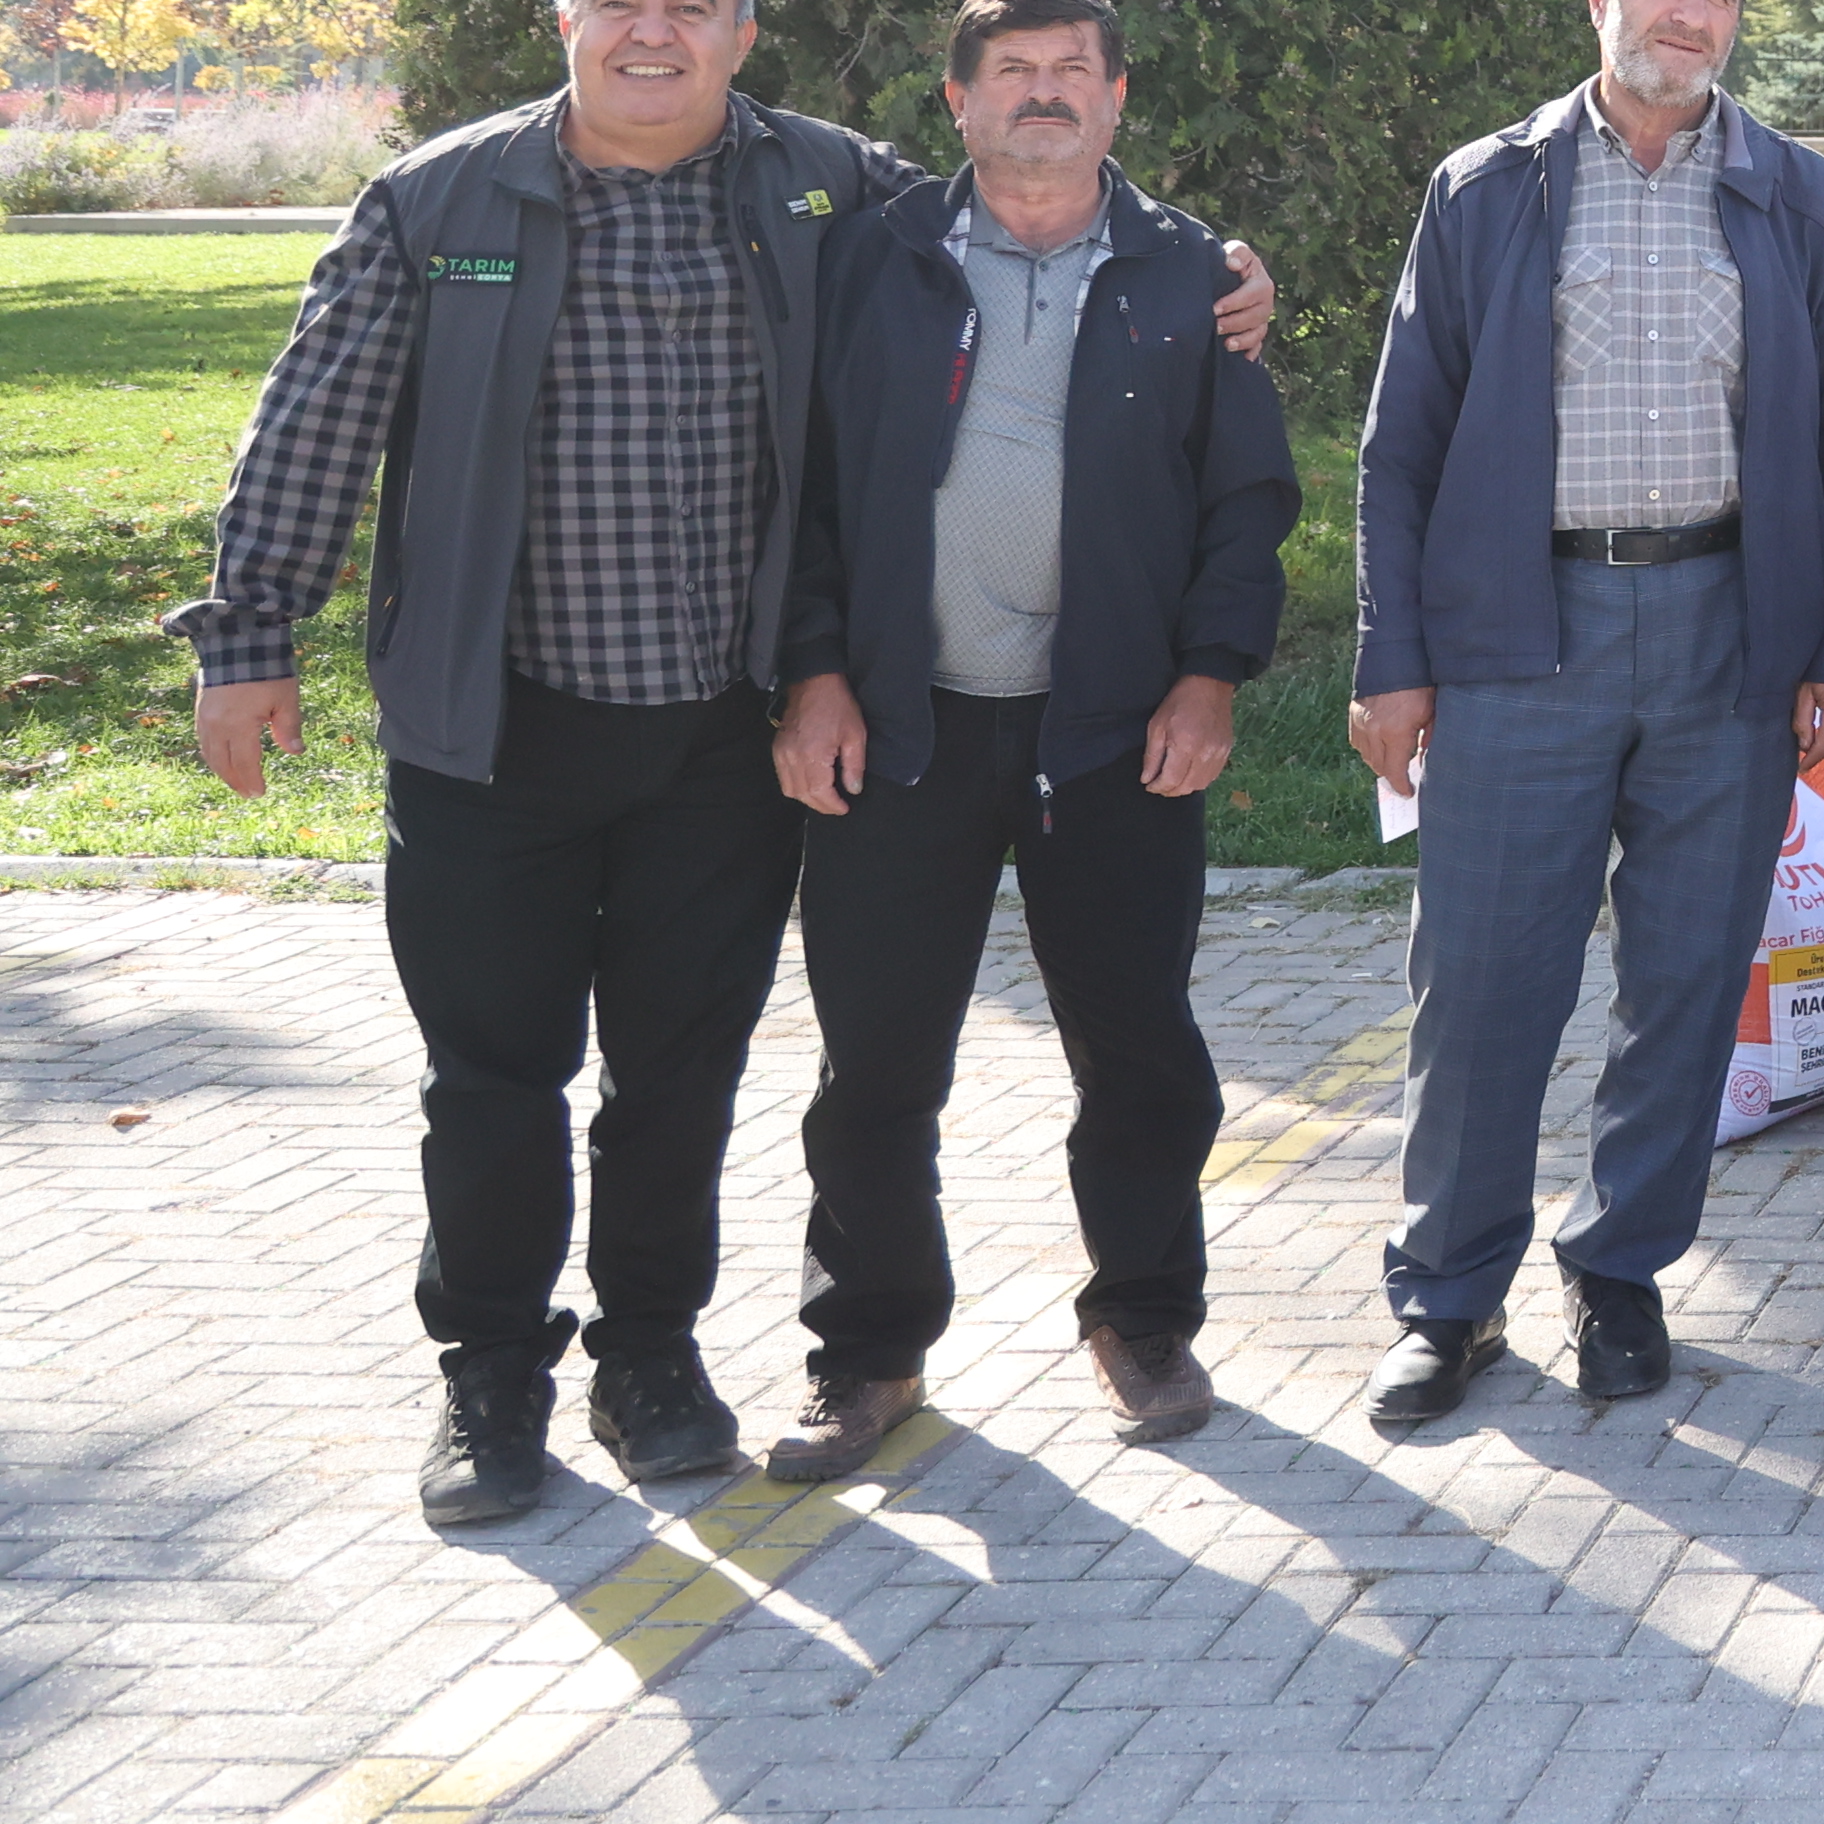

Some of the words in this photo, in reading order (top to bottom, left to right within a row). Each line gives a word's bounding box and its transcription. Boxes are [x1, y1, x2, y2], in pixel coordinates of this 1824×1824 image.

[448, 259, 515, 272] TARIM
[959, 308, 977, 351] TOMMY
[1759, 934, 1795, 948] acar
[1801, 926, 1824, 944] Fiğ
